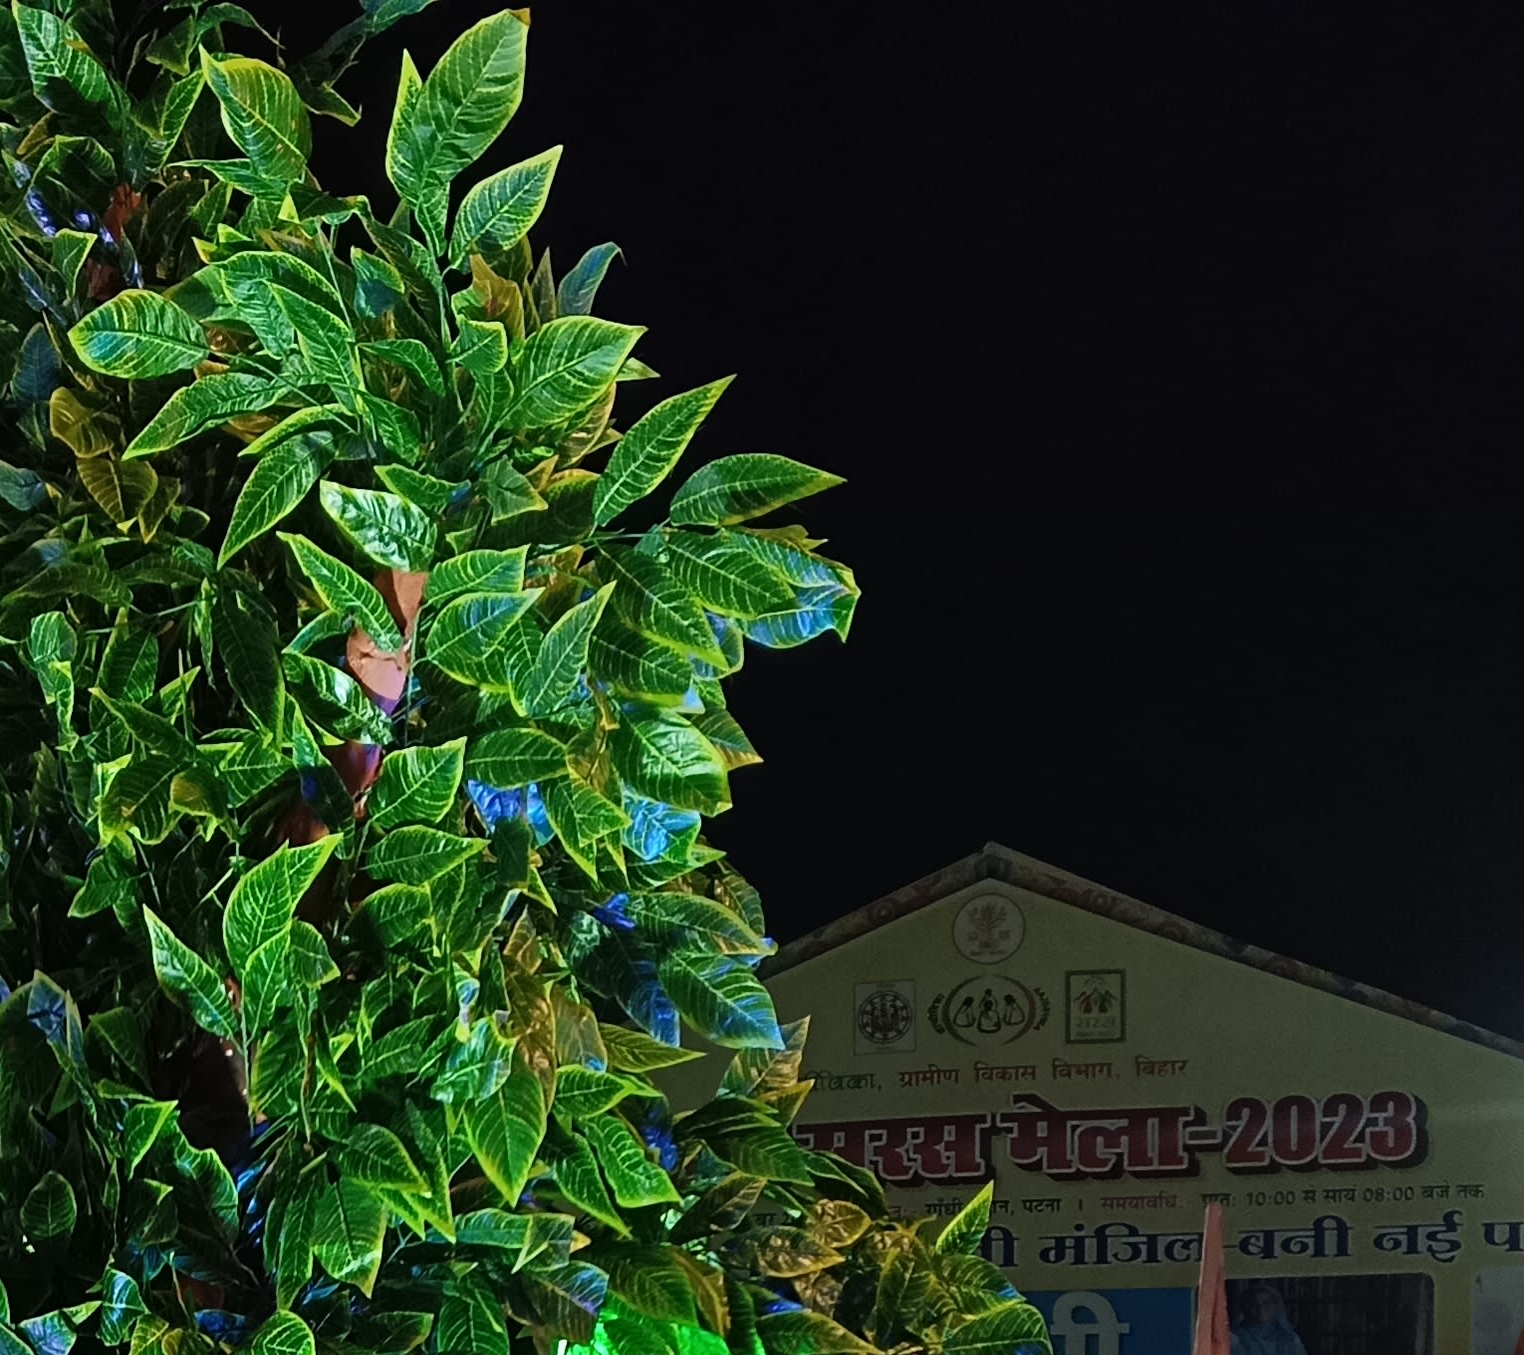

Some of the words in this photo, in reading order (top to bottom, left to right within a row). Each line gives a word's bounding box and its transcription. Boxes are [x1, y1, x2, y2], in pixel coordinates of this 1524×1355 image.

[899, 1062, 960, 1089] ग्रामीण
[974, 1061, 1037, 1082] विकास
[1135, 1055, 1190, 1078] बिहार
[997, 1091, 1421, 1180] मेला-2023
[1022, 1197, 1062, 1214] पटना
[1246, 1190, 1295, 1208] 10:00
[1362, 1185, 1414, 1202] 08:00
[1420, 1181, 1451, 1200] बजे
[1455, 1183, 1486, 1200] तक
[1373, 1209, 1464, 1263] नई
